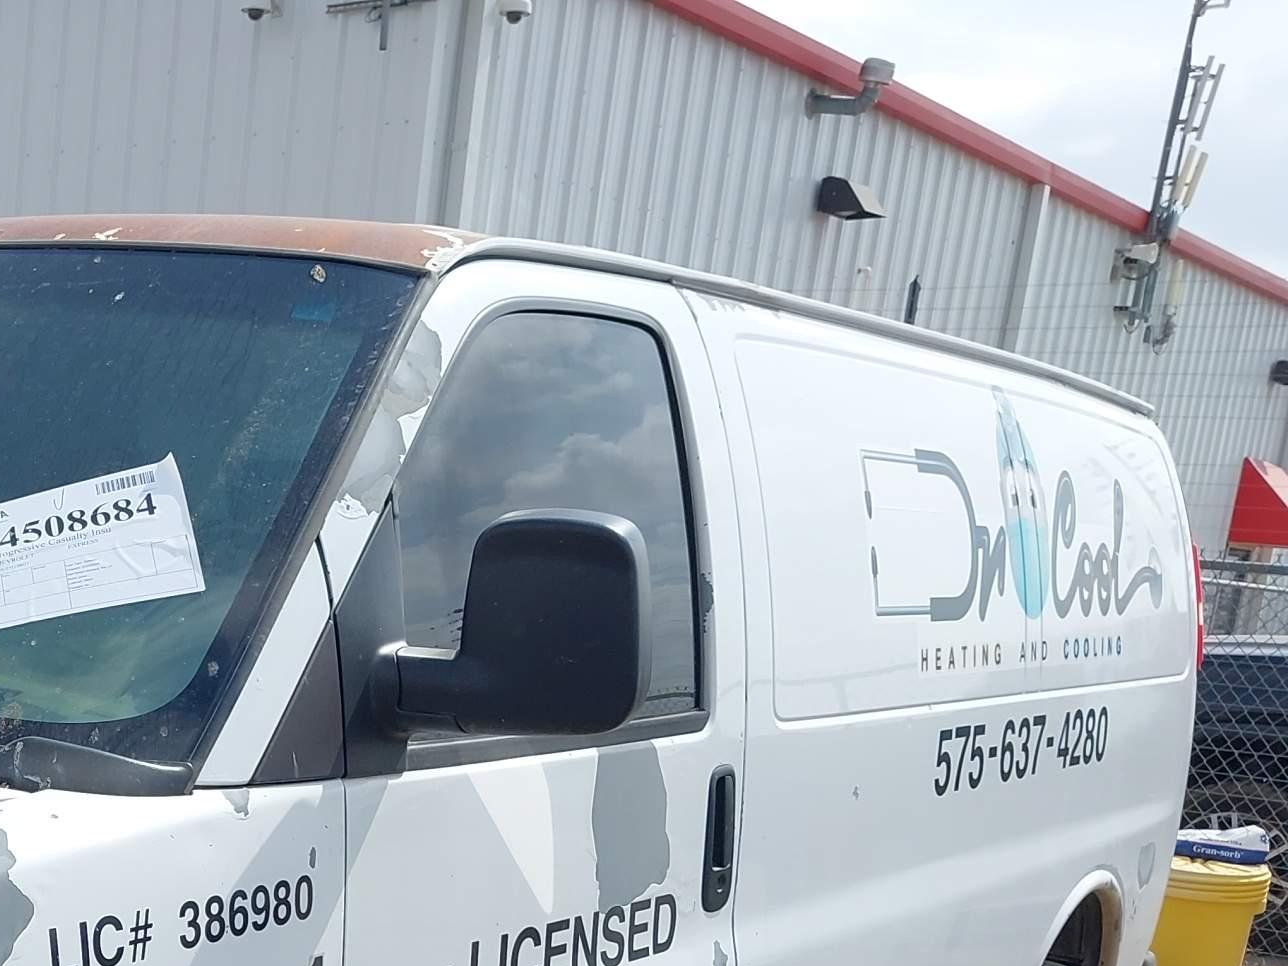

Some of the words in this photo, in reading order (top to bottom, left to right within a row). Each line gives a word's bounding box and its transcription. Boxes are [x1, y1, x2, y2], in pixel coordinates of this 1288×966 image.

[48, 531, 89, 546] Casualty
[91, 526, 112, 537] Insu
[67, 538, 100, 550] EXPRESS
[1051, 469, 1163, 619] Cool
[920, 643, 1002, 672] HEATING
[1019, 640, 1048, 663] AND
[1063, 635, 1122, 660] COOLING
[934, 706, 1109, 797] 575-637-4280
[179, 875, 314, 949] 386980
